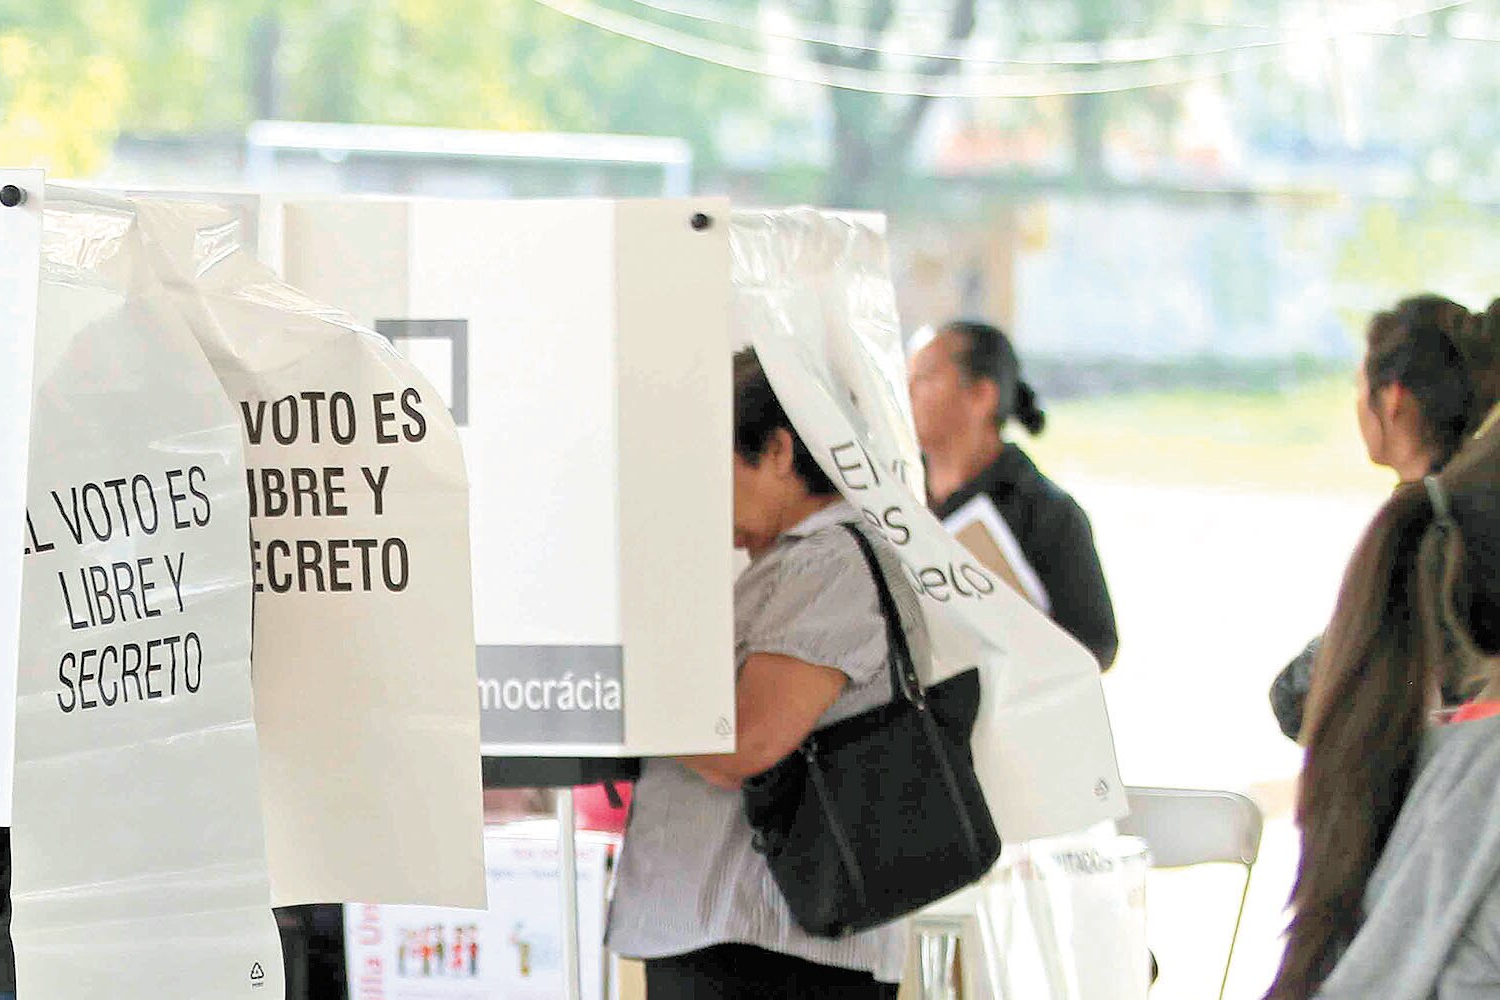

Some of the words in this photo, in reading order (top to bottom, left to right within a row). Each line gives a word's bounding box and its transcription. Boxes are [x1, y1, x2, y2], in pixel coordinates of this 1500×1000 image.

[240, 391, 356, 445] VOTO
[373, 387, 427, 444] ES
[24, 506, 55, 555] L
[51, 474, 159, 545] VOTO
[166, 465, 211, 530] ES
[361, 466, 389, 516] Y
[58, 557, 161, 629] LIBRE
[164, 552, 185, 613] Y
[57, 632, 202, 713] SECRETO
